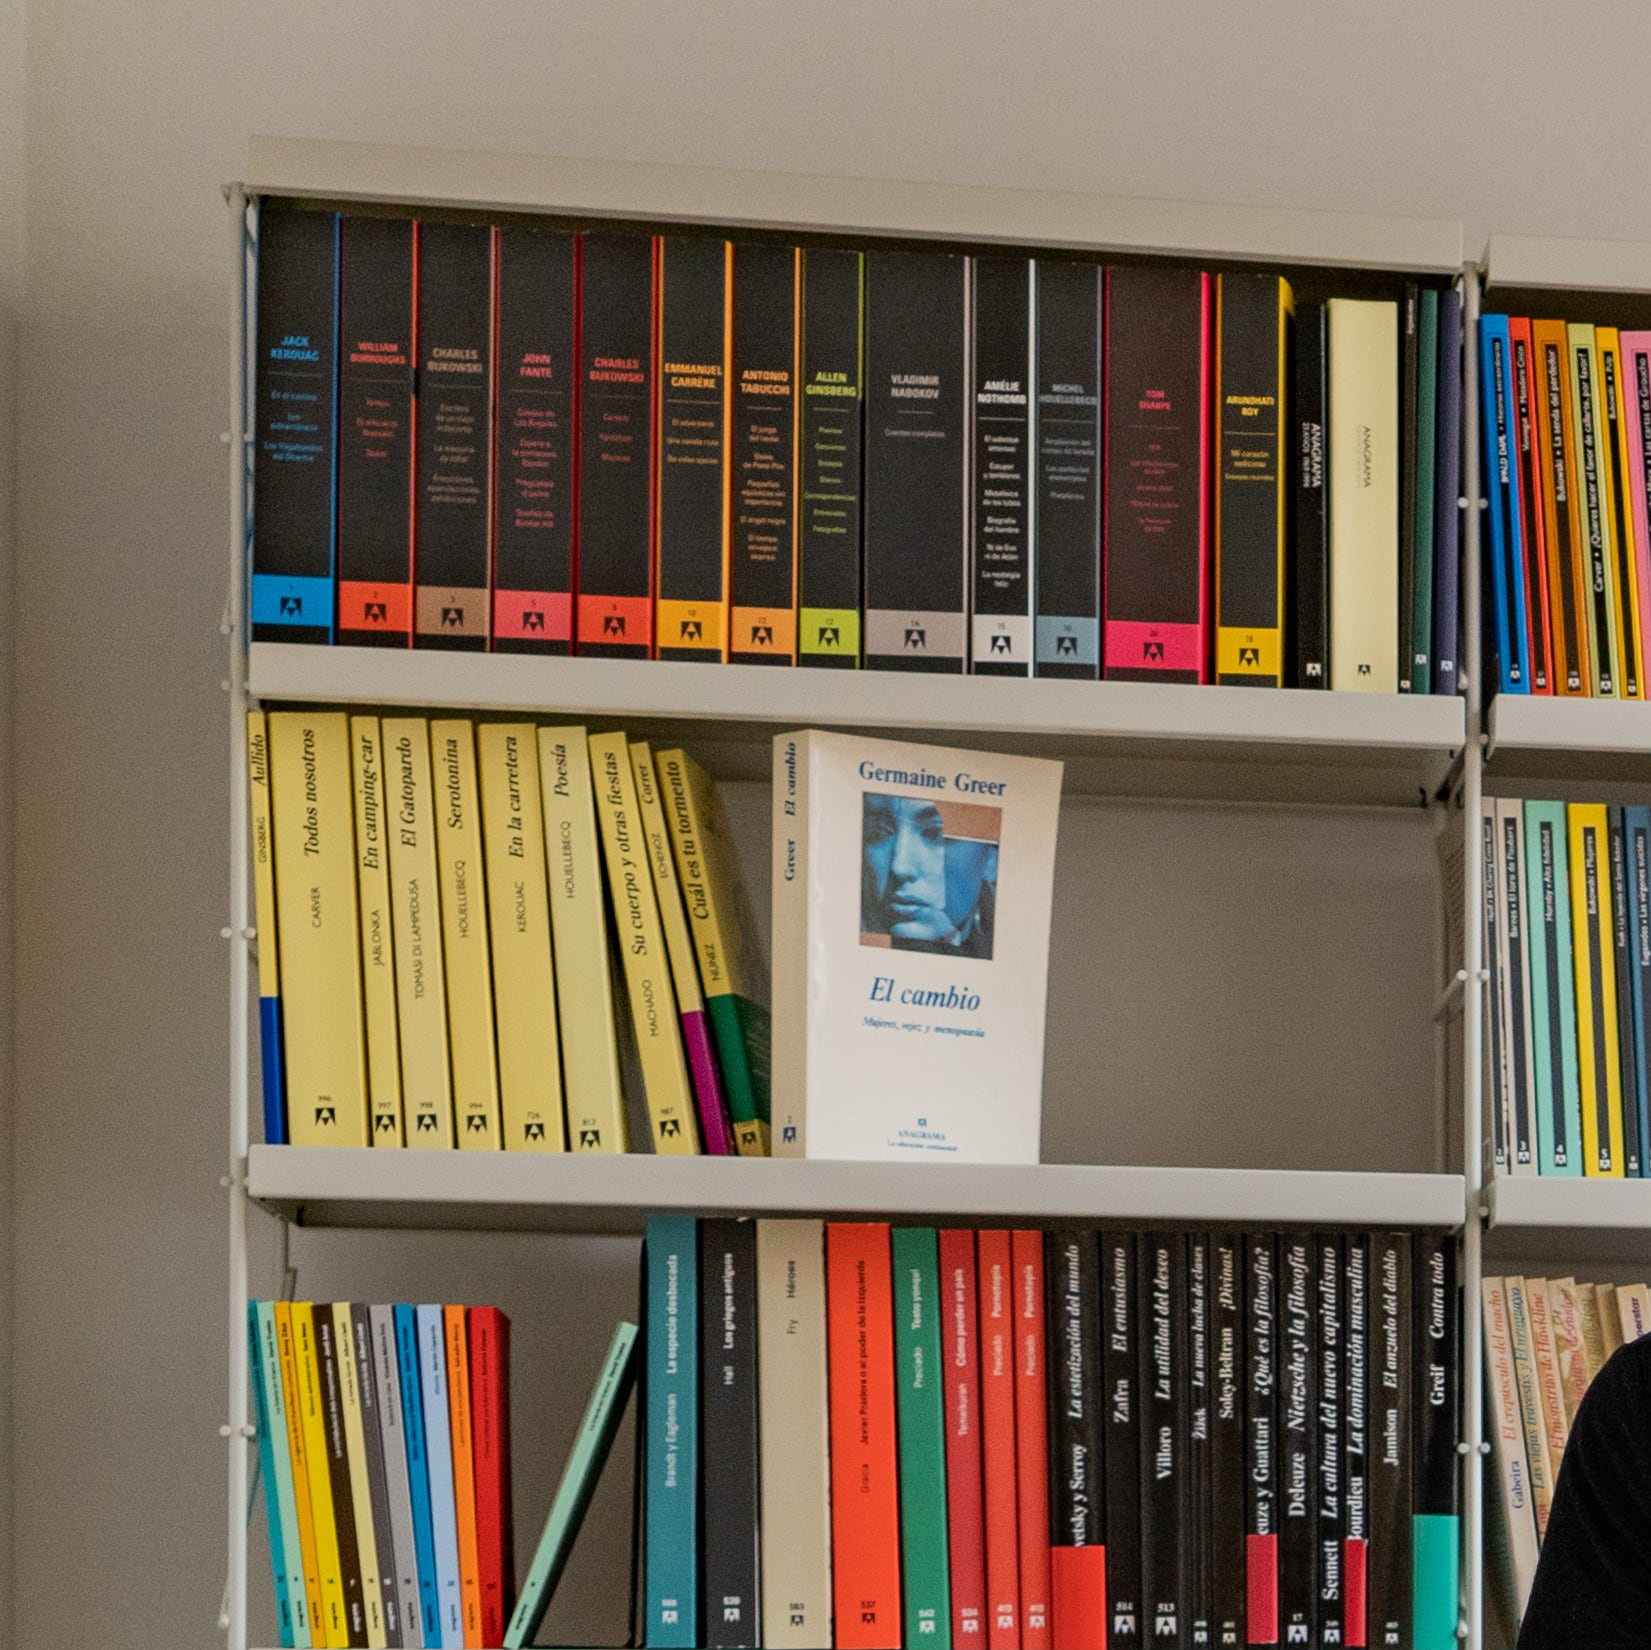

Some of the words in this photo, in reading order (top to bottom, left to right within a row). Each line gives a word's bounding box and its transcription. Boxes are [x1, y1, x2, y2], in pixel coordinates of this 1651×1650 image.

[281, 335, 310, 347] JACK
[432, 348, 479, 360] CHARLES
[522, 353, 551, 365] JOHN
[427, 360, 484, 374] BUKOWSKI
[519, 366, 552, 379] FANTE
[664, 363, 723, 376] EMMANUEL
[741, 370, 789, 383] ANTONIO
[815, 371, 848, 383] ALLEN
[890, 373, 940, 386] VLADIMIR
[983, 379, 1021, 392] AMÉLIE
[740, 383, 791, 396] TABUCCHI
[804, 384, 857, 398] GINSBERG
[890, 387, 940, 400] NABOKOV
[1310, 422, 1322, 488] ANAGRAMA
[300, 727, 317, 803] nosotros
[445, 737, 463, 830] Serotonina
[504, 735, 521, 812] carretera
[549, 743, 570, 797] Poesía
[603, 751, 623, 806] fiestas
[786, 740, 798, 797] cambio
[858, 759, 947, 790] Germaine
[954, 772, 1007, 797] Greer
[358, 734, 379, 842] camping-car
[783, 799, 797, 818] El
[301, 806, 320, 857] Todos
[505, 815, 522, 831] la
[613, 809, 631, 853] otras
[361, 846, 379, 870] En
[507, 835, 524, 859] En
[559, 819, 575, 899] HOUELLEBECQ
[620, 856, 637, 868] y
[783, 838, 796, 882] Greer
[309, 885, 322, 929] CARVER
[453, 858, 469, 939] HOUELLEBECQ
[513, 880, 527, 933] KEROUAC
[623, 870, 644, 930] cuerpo
[369, 908, 385, 967] JABLONKA
[630, 933, 648, 956] Su
[640, 978, 659, 1037] MACHADO
[869, 976, 895, 1003] El
[899, 983, 981, 1013] cambio
[665, 1253, 678, 1315] desbocada
[721, 1251, 735, 1294] antiguos
[1110, 1246, 1127, 1332] entusiasmo
[1152, 1247, 1169, 1290] deseo
[1217, 1246, 1237, 1311] ¡Divinas!
[1286, 1244, 1309, 1318] filosofía
[1345, 1246, 1364, 1331] masculina
[1428, 1251, 1444, 1285] todo
[722, 1293, 736, 1331] griegos
[1152, 1290, 1170, 1316] del
[1318, 1246, 1341, 1346] capitalismo
[1427, 1286, 1445, 1339] Contra
[1487, 1288, 1504, 1332] macho
[665, 1314, 680, 1360] especie
[722, 1330, 734, 1349] Los
[1110, 1332, 1127, 1352] El
[1152, 1316, 1170, 1376] utilidad
[1286, 1318, 1305, 1337] la
[1291, 1338, 1310, 1353] y
[1490, 1333, 1507, 1355] del
[664, 1358, 678, 1374] La
[722, 1364, 734, 1385] Hall
[1217, 1326, 1236, 1419] Soley-Beltran
[1323, 1349, 1337, 1400] nuevo
[1345, 1332, 1364, 1429] dominación
[1428, 1362, 1445, 1406] Greif
[1112, 1378, 1129, 1423] Zafra
[1153, 1378, 1171, 1400] La
[1286, 1351, 1306, 1432] Nietzsche
[1494, 1356, 1516, 1424] crepúsculo
[663, 1392, 679, 1443] Eagleman
[1318, 1400, 1337, 1429] del
[1501, 1425, 1517, 1441] El
[667, 1443, 679, 1451] y
[1155, 1425, 1172, 1479] Villoro
[1319, 1432, 1338, 1492] cultura
[1345, 1430, 1364, 1455] La
[663, 1451, 677, 1488] Brandt
[1287, 1451, 1306, 1516] Deleuze
[1510, 1459, 1524, 1509] Gabeira
[1319, 1494, 1338, 1519] La
[1320, 1539, 1339, 1600] Sennett
